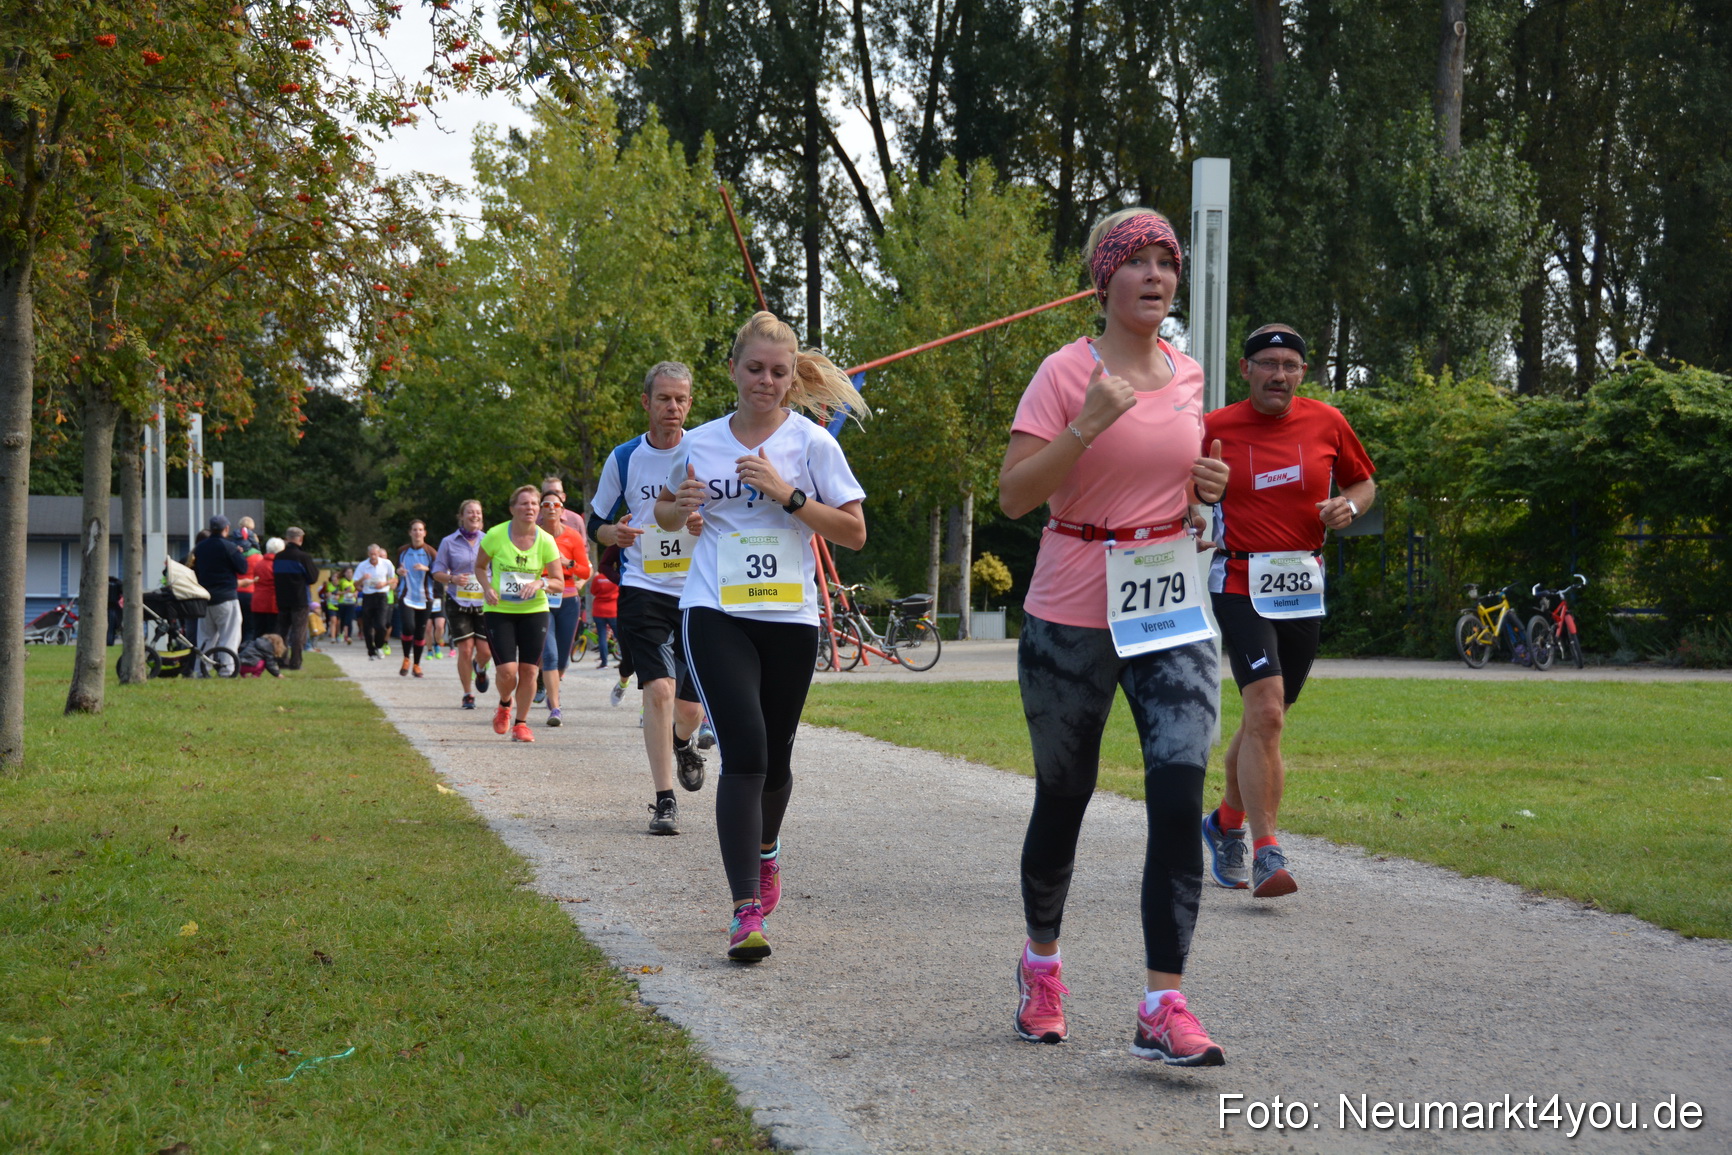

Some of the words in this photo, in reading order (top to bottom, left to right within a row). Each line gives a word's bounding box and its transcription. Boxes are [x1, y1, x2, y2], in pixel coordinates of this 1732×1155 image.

[1267, 473, 1287, 483] DEHN
[749, 536, 779, 544] BOCK
[660, 539, 681, 557] 54
[1144, 550, 1175, 565] BOCK
[663, 561, 681, 570] Didier
[746, 554, 777, 579] 39
[1260, 572, 1312, 593] 2438
[748, 587, 778, 598] Bianca
[1120, 571, 1186, 613] 2179
[1273, 598, 1299, 608] Helmut
[1140, 619, 1176, 633] Verena
